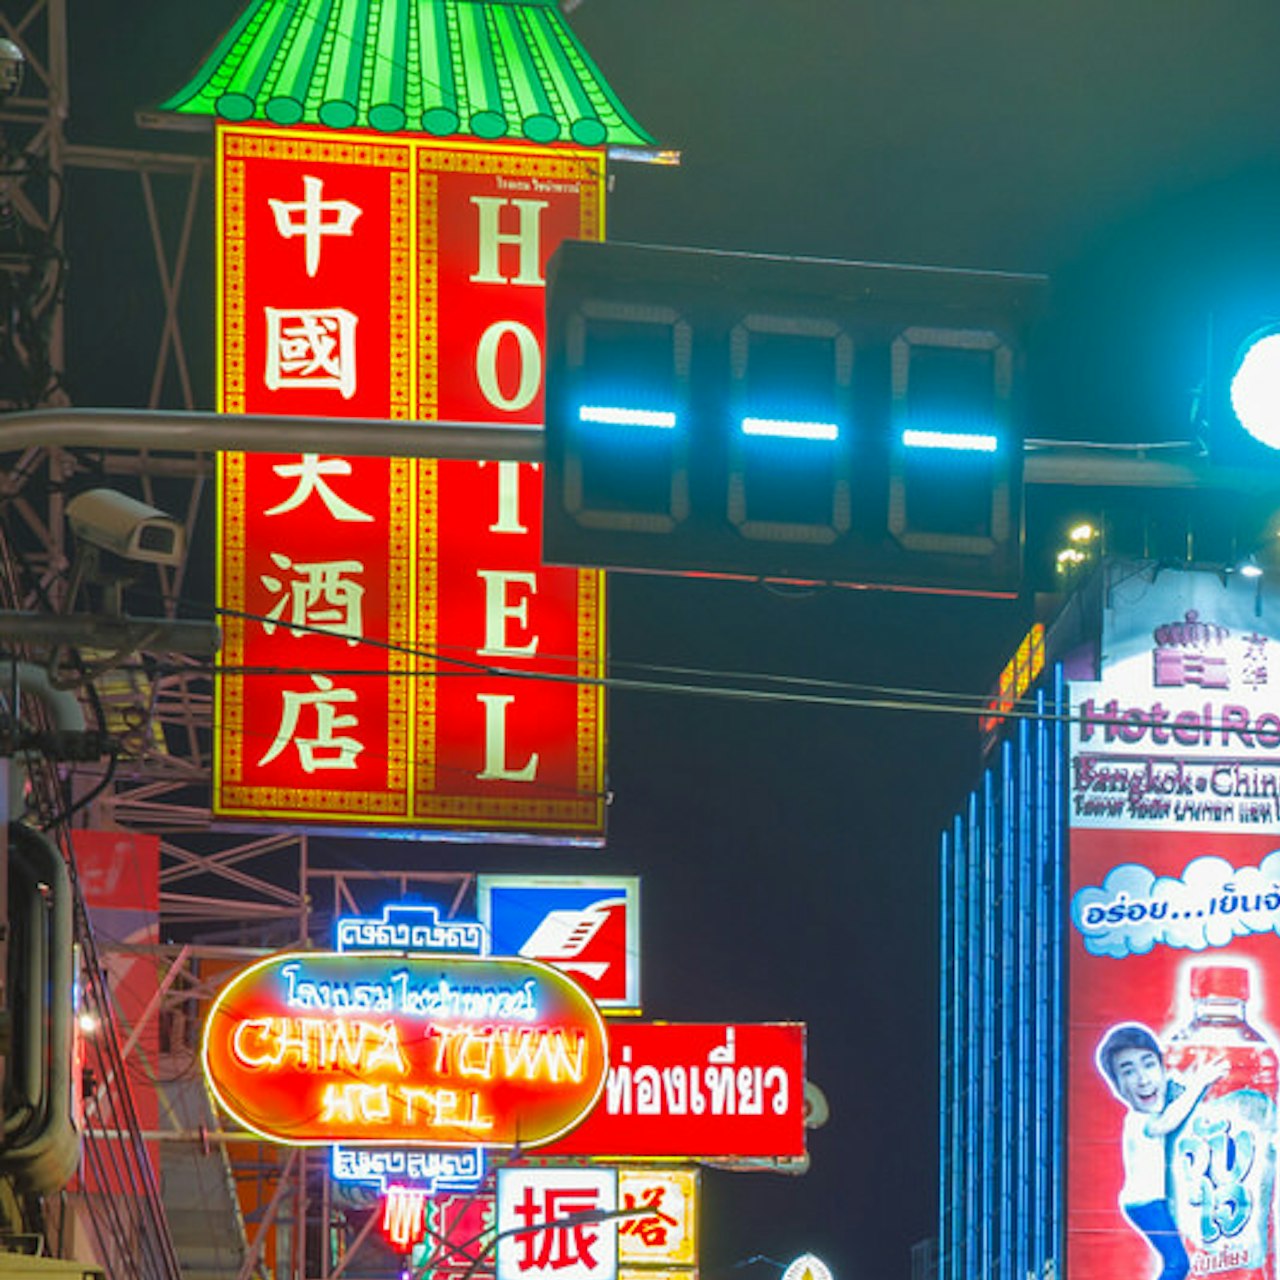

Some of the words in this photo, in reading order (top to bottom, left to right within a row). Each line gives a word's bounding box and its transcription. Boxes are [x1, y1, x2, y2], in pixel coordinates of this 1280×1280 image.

[469, 196, 549, 784] HOTEL
[1080, 698, 1213, 747] Hotel
[234, 1018, 410, 1075] CHINA
[424, 1022, 589, 1085] TOWN
[318, 1081, 495, 1130] HOTEL
